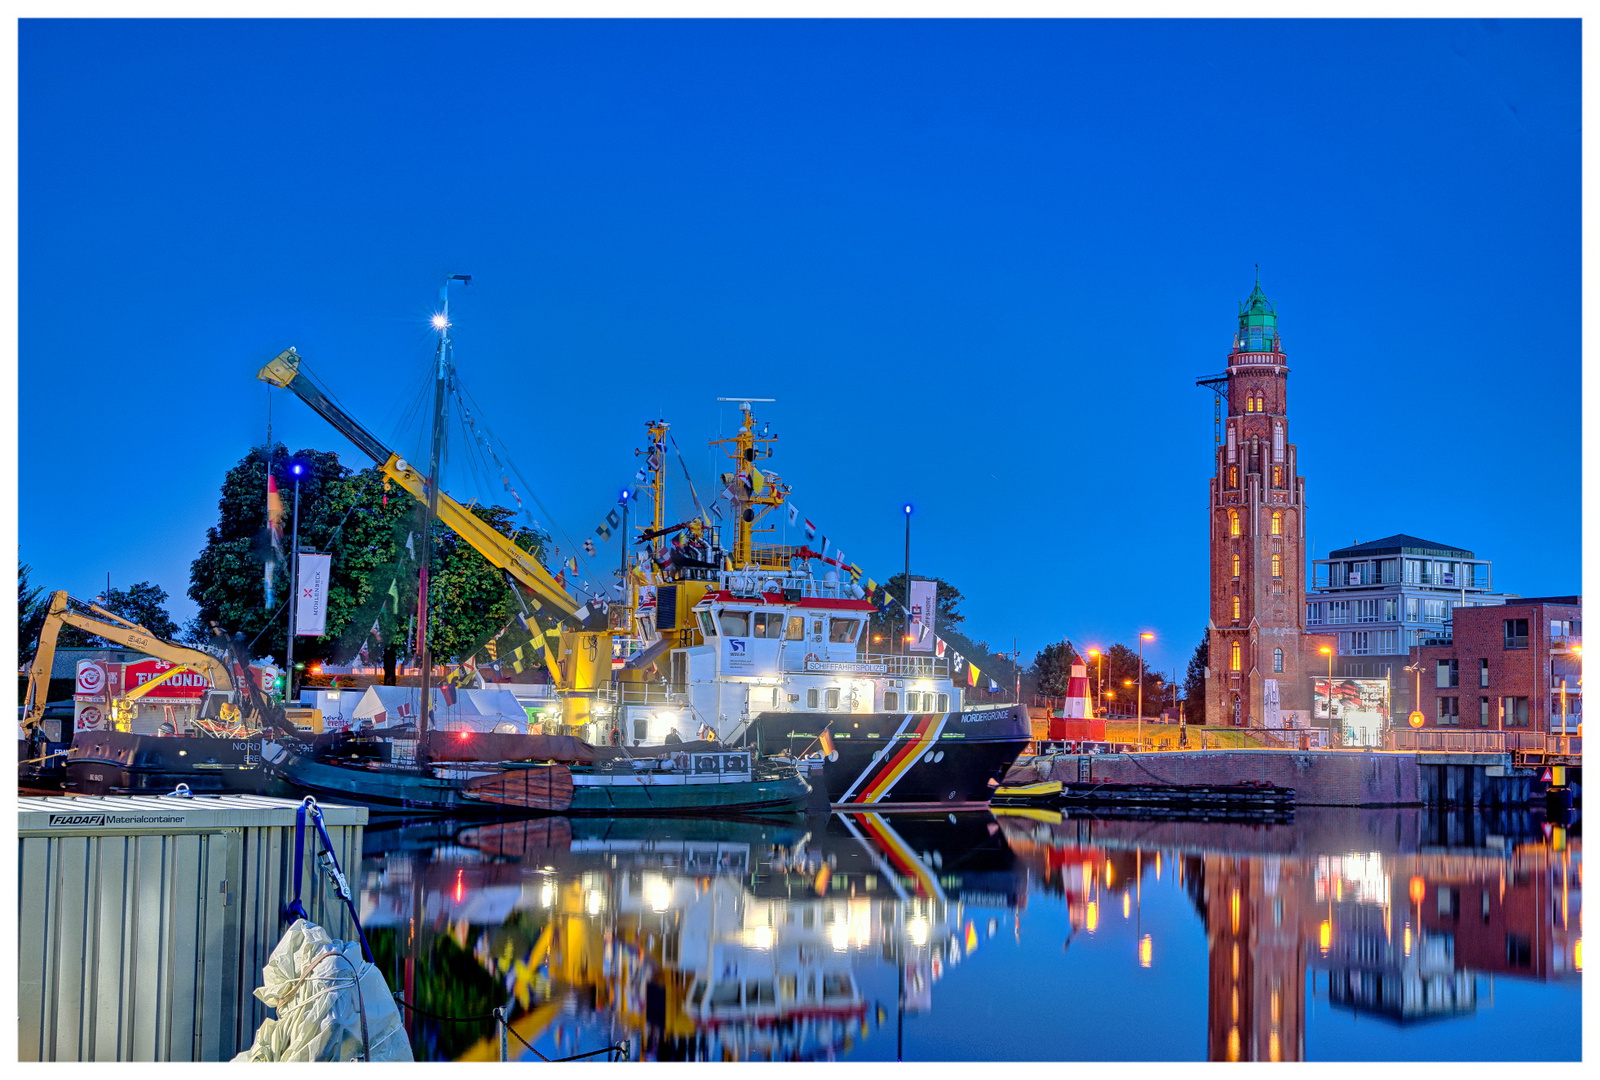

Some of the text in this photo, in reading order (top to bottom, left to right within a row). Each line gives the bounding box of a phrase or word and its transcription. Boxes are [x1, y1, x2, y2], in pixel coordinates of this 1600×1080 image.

[810, 663, 886, 672] SCHIFFFAHRTSPOLIZEI
[54, 815, 185, 825] FLADAFI Materialcontainer
